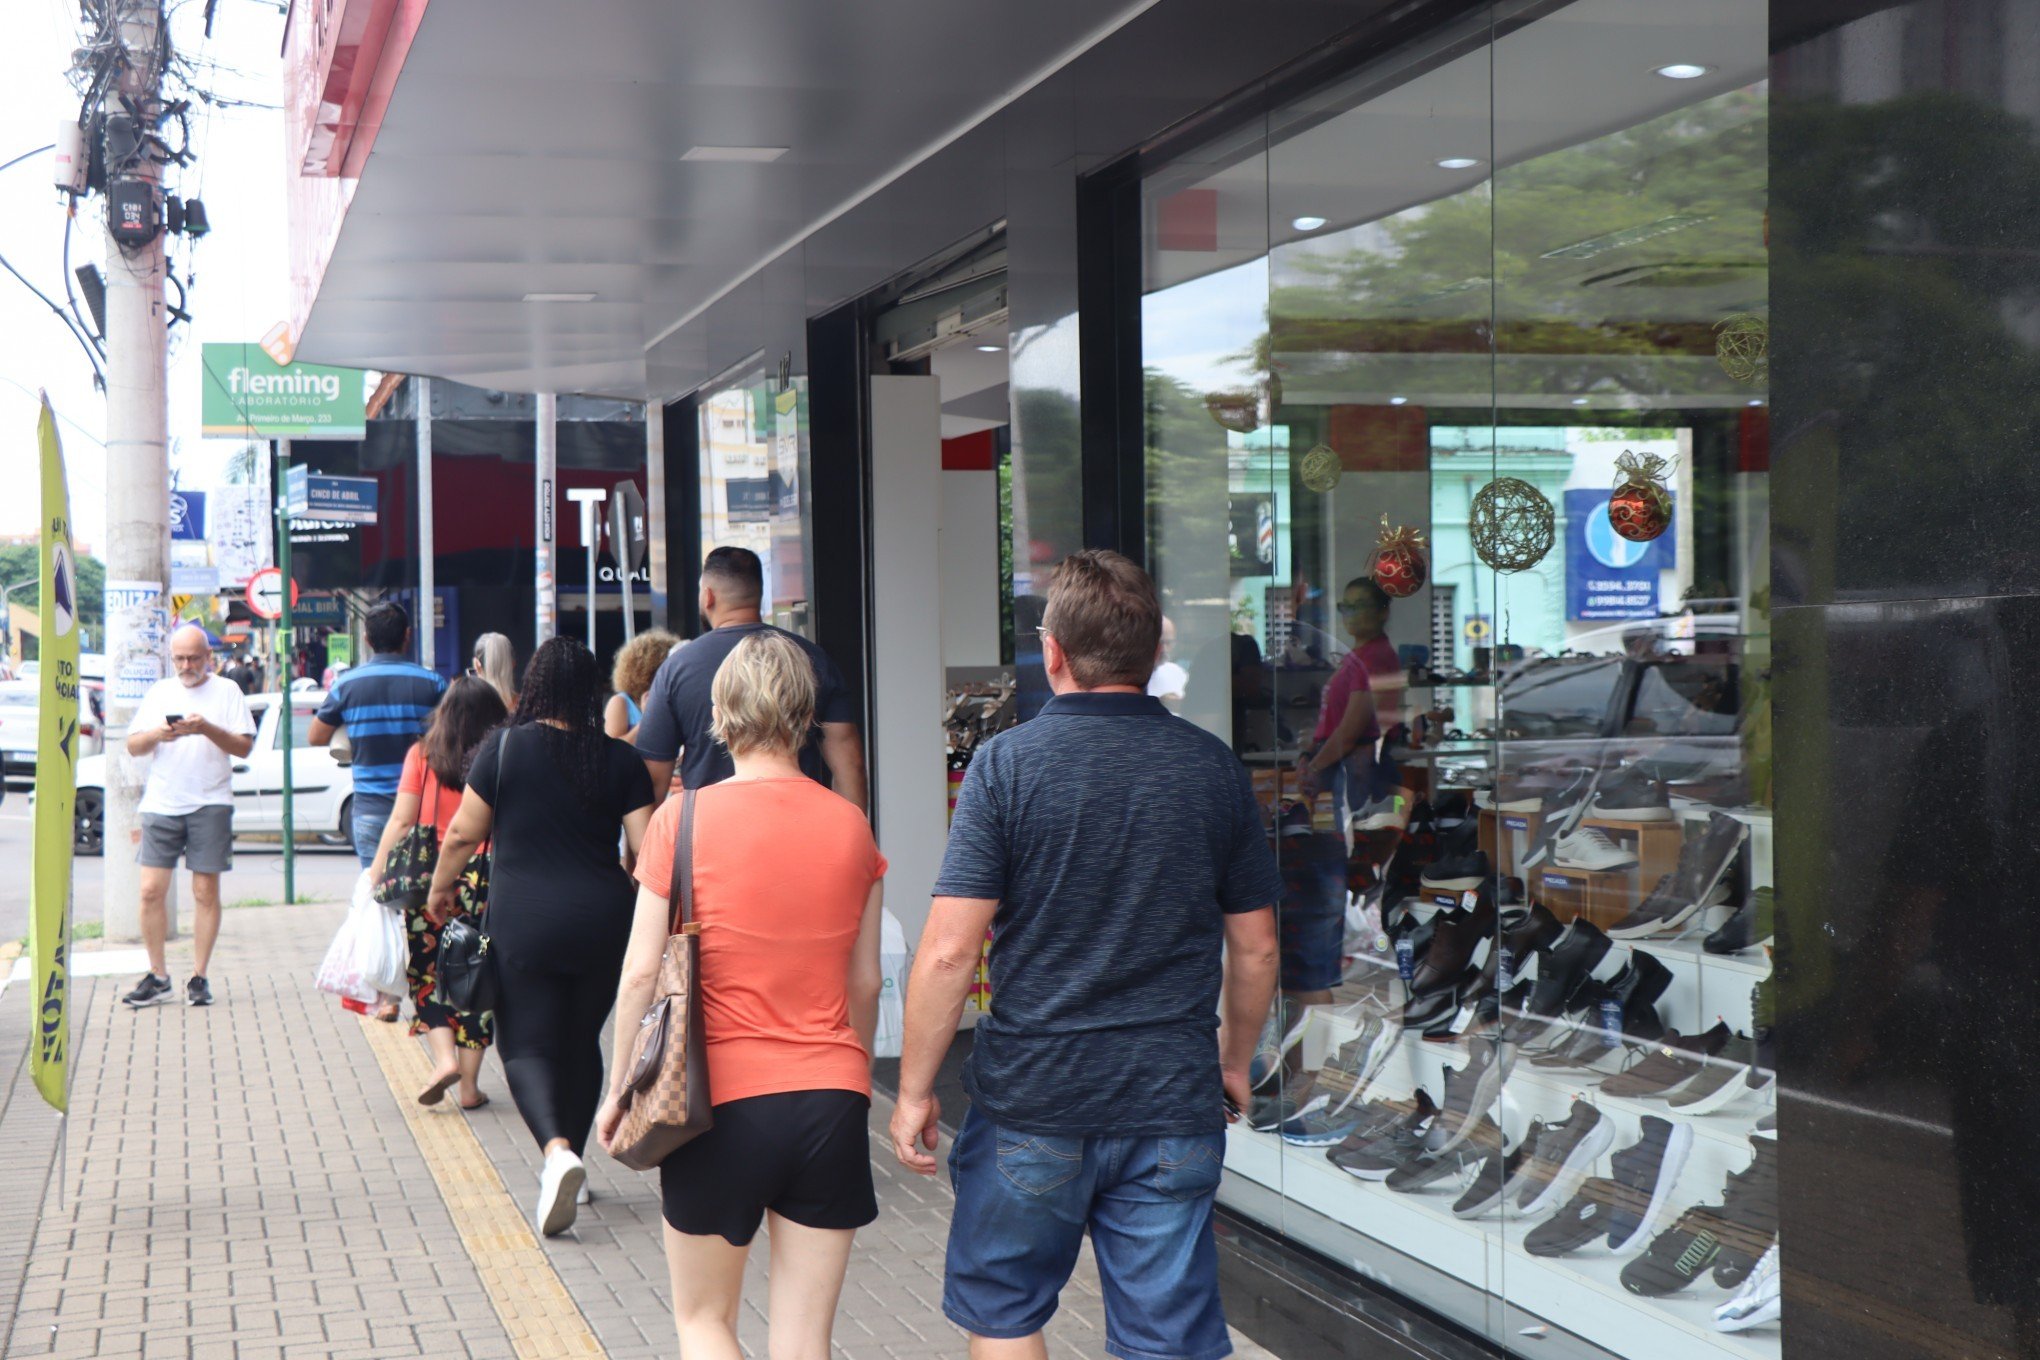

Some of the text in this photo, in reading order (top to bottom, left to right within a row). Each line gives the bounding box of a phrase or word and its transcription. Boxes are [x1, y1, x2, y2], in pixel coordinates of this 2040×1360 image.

[228, 367, 340, 401] fleming
[311, 489, 359, 501] CINCO DE ABRIL
[1674, 1229, 1719, 1276] PUMA
